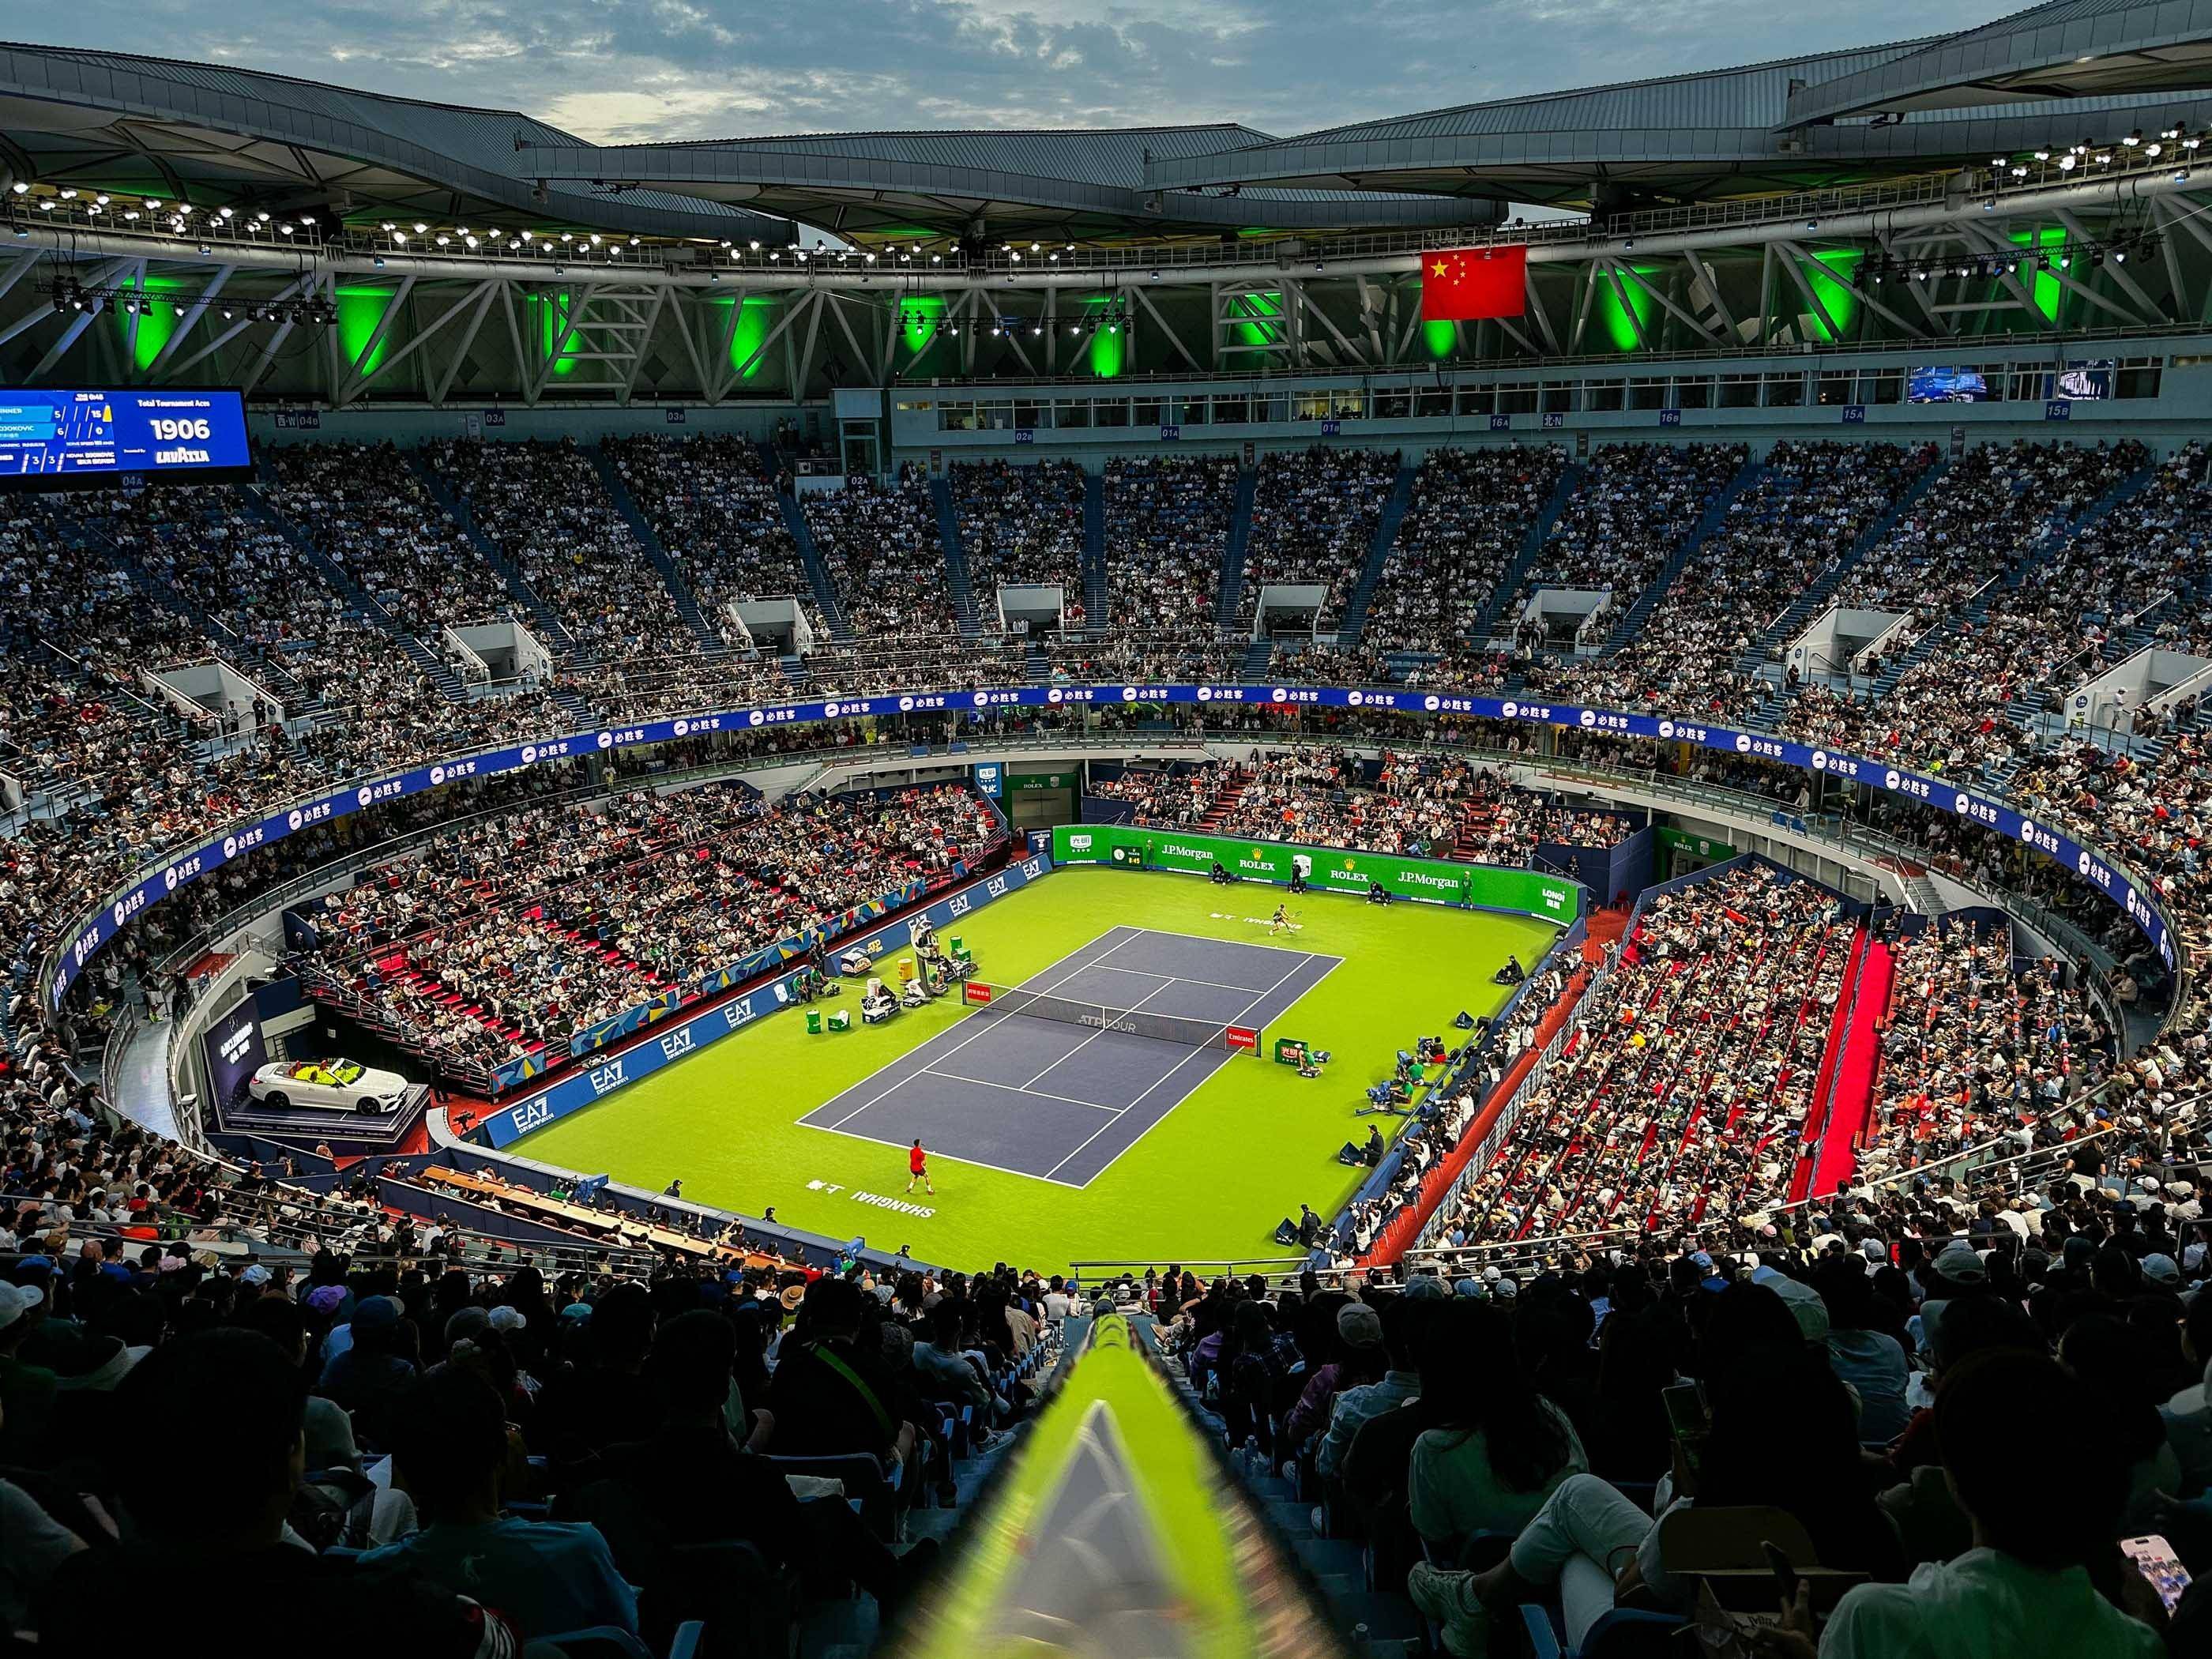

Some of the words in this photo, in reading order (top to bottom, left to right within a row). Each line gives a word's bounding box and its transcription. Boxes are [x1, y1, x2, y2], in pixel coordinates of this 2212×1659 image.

[156, 399, 194, 408] Tournament
[2048, 404, 2068, 416] 15B
[91, 410, 102, 419] 15
[299, 414, 318, 425] 04B
[486, 414, 504, 423] 03A
[668, 412, 684, 421] 03B
[1661, 412, 1680, 423] 16B
[1845, 409, 1863, 419] 15A
[150, 419, 211, 440] 1906
[1322, 423, 1340, 433] 01B
[1492, 418, 1509, 427] 16A
[95, 427, 103, 435] 0
[1016, 432, 1033, 442] 02B
[1162, 429, 1179, 438] 01A
[48, 456, 56, 465] 3
[156, 446, 210, 464] LAVAZZA
[122, 476, 143, 486] 04A
[851, 476, 868, 485] 02A
[990, 692, 1020, 703] 必胜客
[1064, 690, 1093, 700] 必胜客
[1138, 689, 1168, 699] 必胜客
[1213, 689, 1243, 699] 必胜客
[1288, 690, 1319, 702] 必胜客
[1364, 694, 1394, 705] 必胜客
[841, 702, 871, 714] 必胜客
[916, 697, 945, 708] 必胜客
[1442, 698, 1472, 711] 必胜客
[766, 709, 796, 722] 必胜客
[1519, 705, 1550, 719] 必胜客
[690, 718, 720, 732] 必胜客
[1597, 714, 1628, 729] 必胜客
[614, 729, 645, 743] 必胜客
[1675, 725, 1707, 742] 必胜客
[538, 743, 568, 758] 必胜客
[1752, 739, 1783, 757] 必胜客
[446, 762, 476, 778] 必胜客
[1828, 755, 1859, 776] 必胜客
[373, 781, 403, 798] 必胜客
[1901, 777, 1930, 797] 必胜客
[303, 803, 331, 823] 必胜客
[1969, 802, 1997, 823] 必胜客
[238, 829, 263, 849] 必胜客
[2034, 830, 2059, 853] 必胜客
[1161, 844, 1214, 861] J.P.Morgan
[1674, 841, 1693, 852] ROLEX
[178, 857, 201, 880] 必胜客
[1022, 859, 1039, 877] EA7
[1239, 859, 1275, 871] ROLEX
[1330, 870, 1368, 882] ROLEX
[1398, 871, 1458, 890] J.P.Morgan
[2090, 865, 2112, 888] 必胜客
[988, 876, 1005, 894] EA7
[124, 890, 145, 915] 必胜客
[949, 894, 968, 913] EA7
[2135, 900, 2150, 927] 必胜客
[82, 927, 99, 954] 必胜客
[724, 999, 752, 1025] EA7
[1078, 1014, 1103, 1026] ATP
[1105, 1018, 1137, 1033] TOUR
[660, 1028, 691, 1056] EA7
[1228, 1033, 1254, 1044] Emirates
[590, 1060, 623, 1090] EA7
[511, 1096, 547, 1130] EA7
[850, 1191, 936, 1218] SHANGHAI
